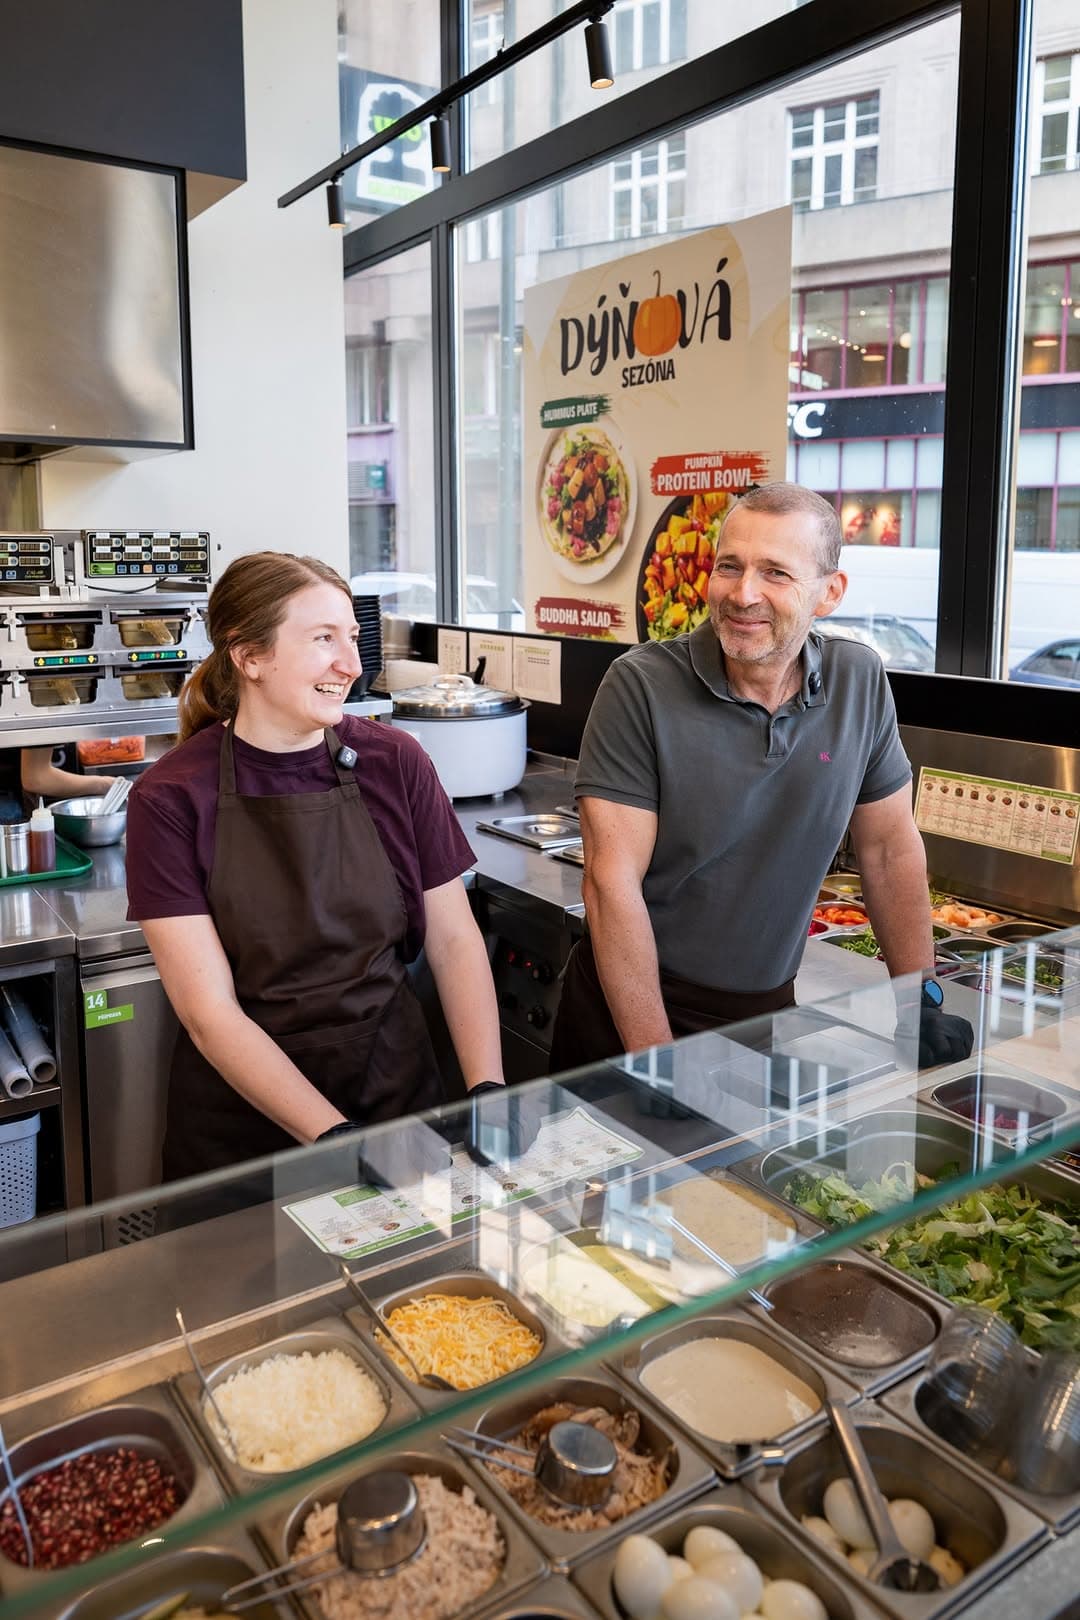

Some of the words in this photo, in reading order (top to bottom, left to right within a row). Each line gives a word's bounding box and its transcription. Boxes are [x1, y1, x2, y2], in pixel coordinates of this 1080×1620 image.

[621, 358, 676, 388] SEZÓNA
[543, 405, 576, 421] HUMMUS
[576, 402, 598, 417] PLATE
[684, 455, 724, 470] PUMPKIN
[657, 470, 711, 491] PROTEIN
[713, 468, 754, 488] BOWL
[540, 607, 579, 626] BUDDHA
[580, 610, 612, 628] SALAD
[86, 993, 105, 1009] 14
